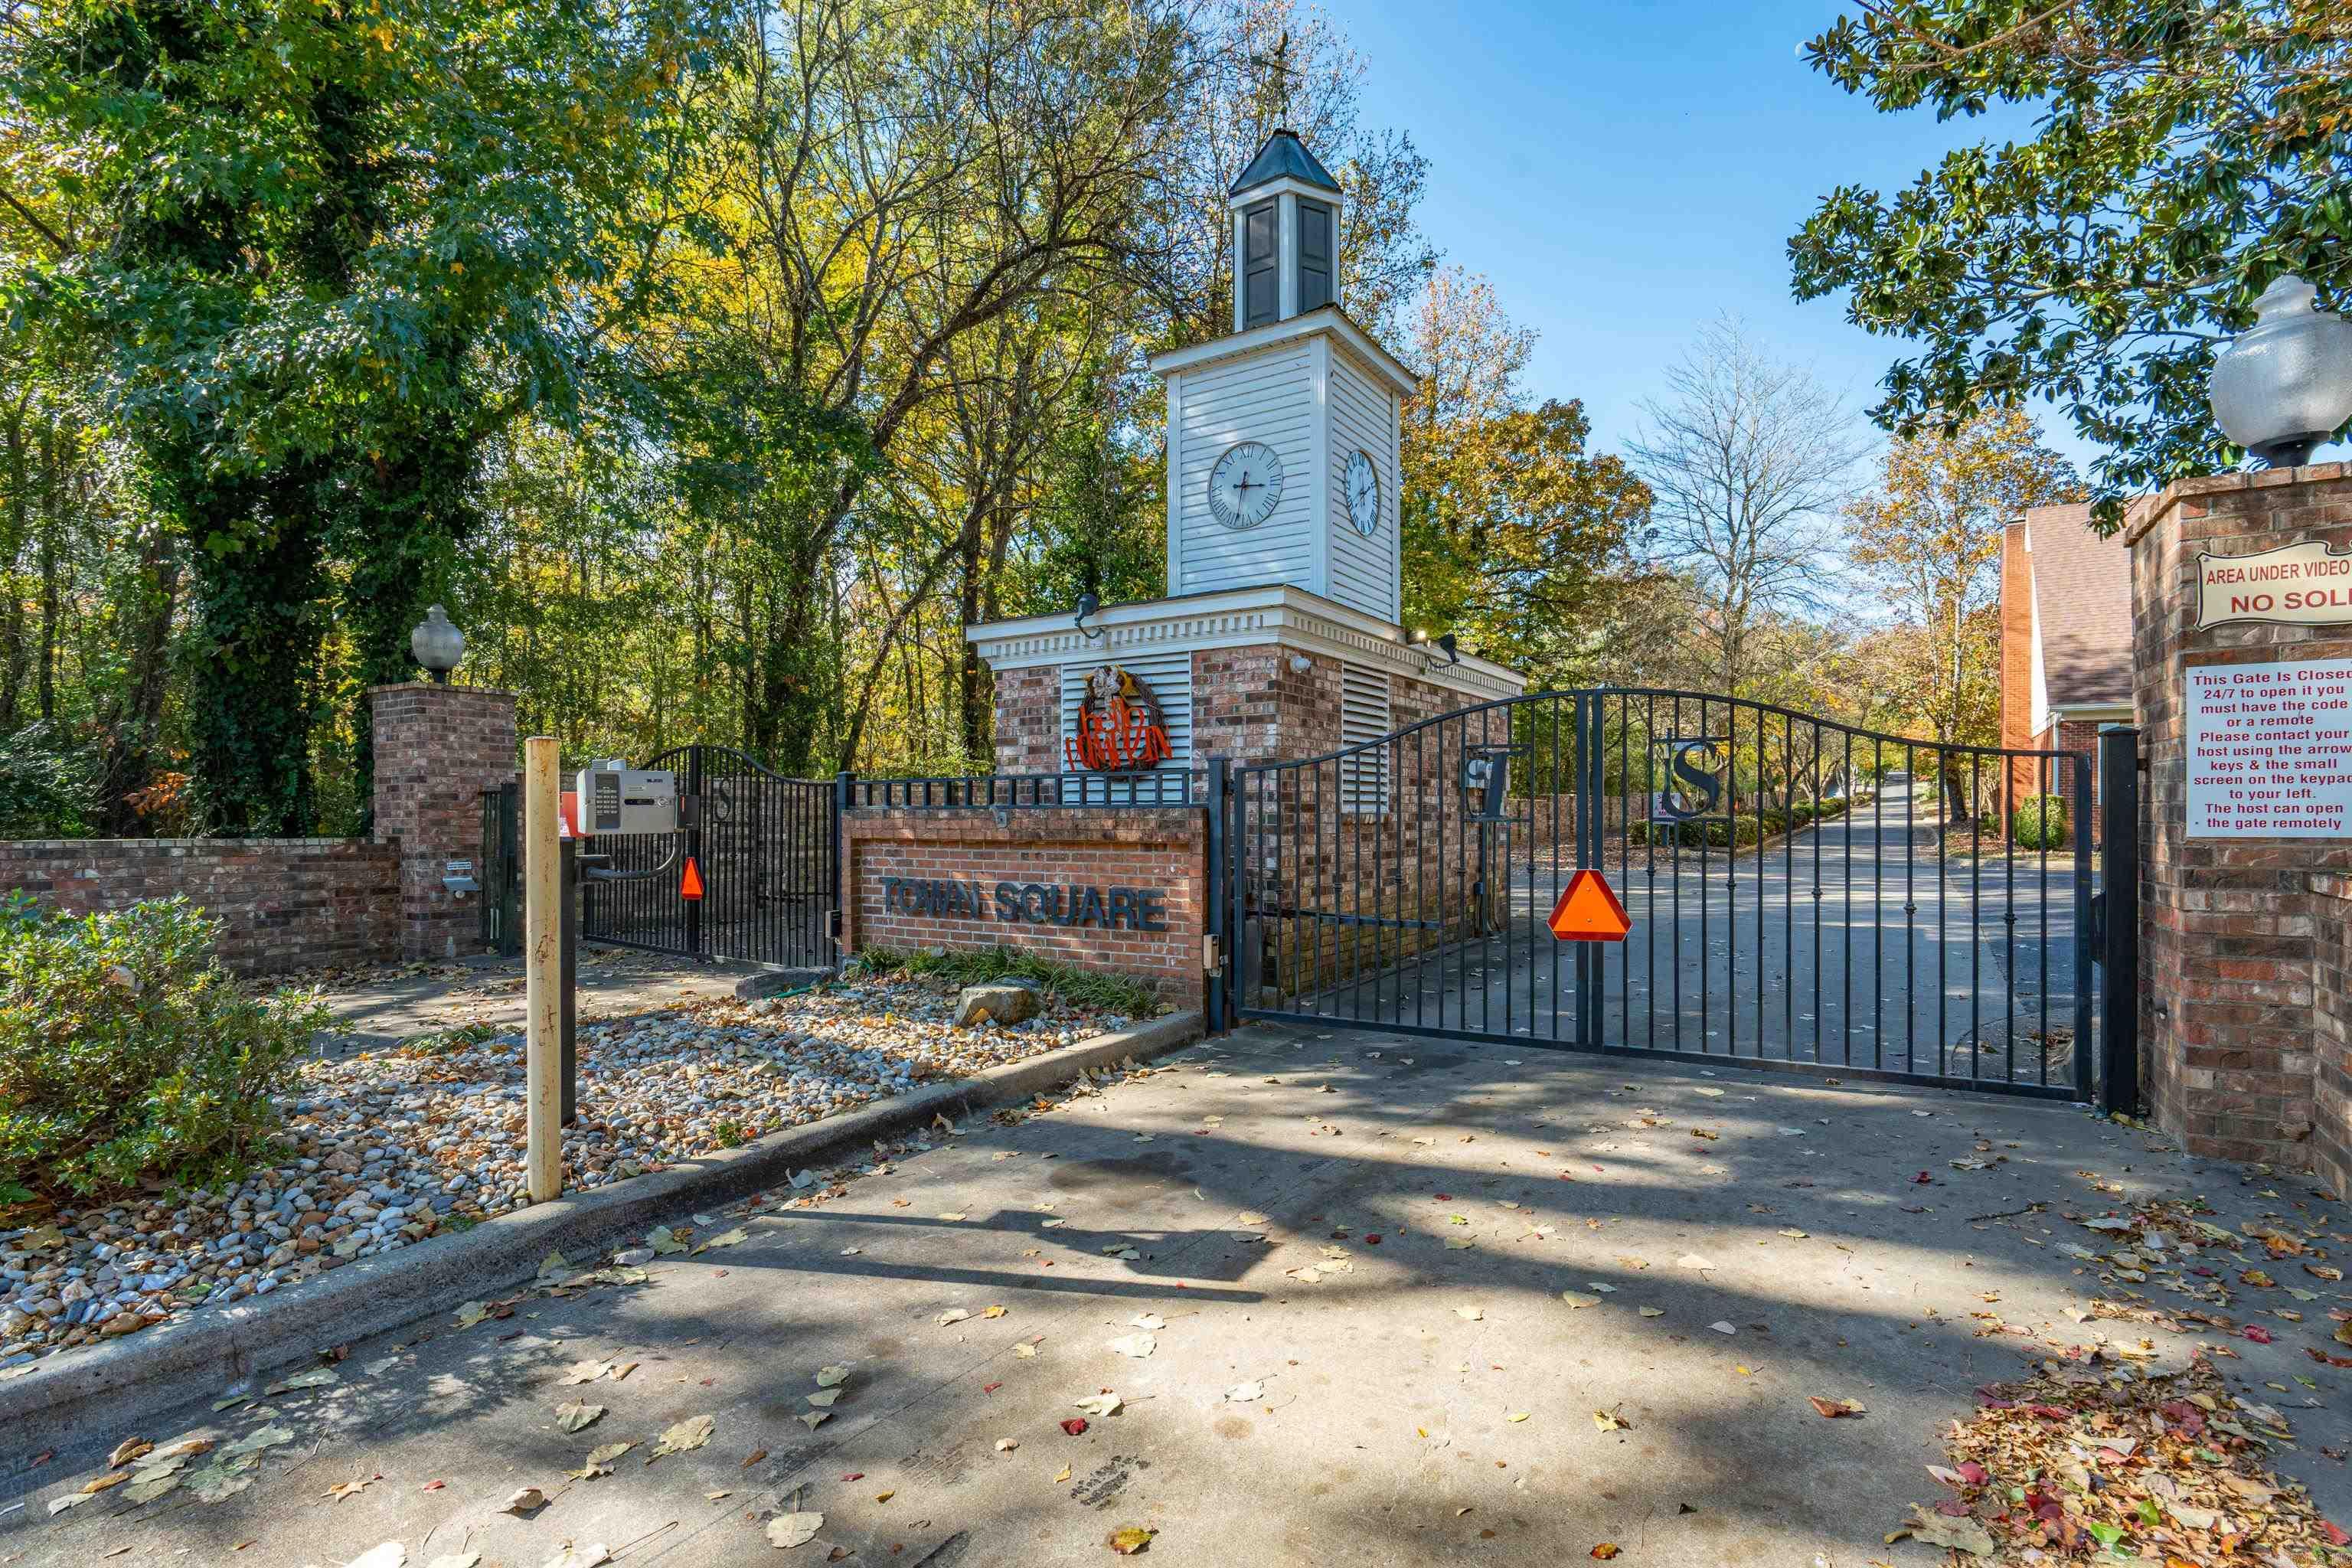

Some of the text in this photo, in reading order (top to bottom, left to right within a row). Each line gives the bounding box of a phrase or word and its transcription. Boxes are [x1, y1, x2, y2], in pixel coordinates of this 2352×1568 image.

[2206, 560, 2350, 585] AREA UNDER VIDEO
[2231, 594, 2274, 613] NO
[2193, 675, 2227, 685] This
[2233, 673, 2270, 684] Gate
[2277, 672, 2291, 681] Is
[2203, 685, 2344, 700] 24/7 to open it you
[2201, 699, 2348, 714] must have the code
[2226, 715, 2314, 727] or a remote
[2200, 730, 2350, 742] Please contact your
[2197, 745, 2352, 757] host using the arrow
[2210, 759, 2337, 772] keys & the small
[1662, 741, 1720, 820] S
[2194, 776, 2243, 785] screen
[2249, 776, 2265, 784] on
[2272, 774, 2295, 784] the
[2230, 789, 2316, 801] to your left.
[2205, 803, 2344, 815] The host can open
[2207, 818, 2341, 830] the gate remotely
[881, 877, 1165, 931] TOWN SQUARE
